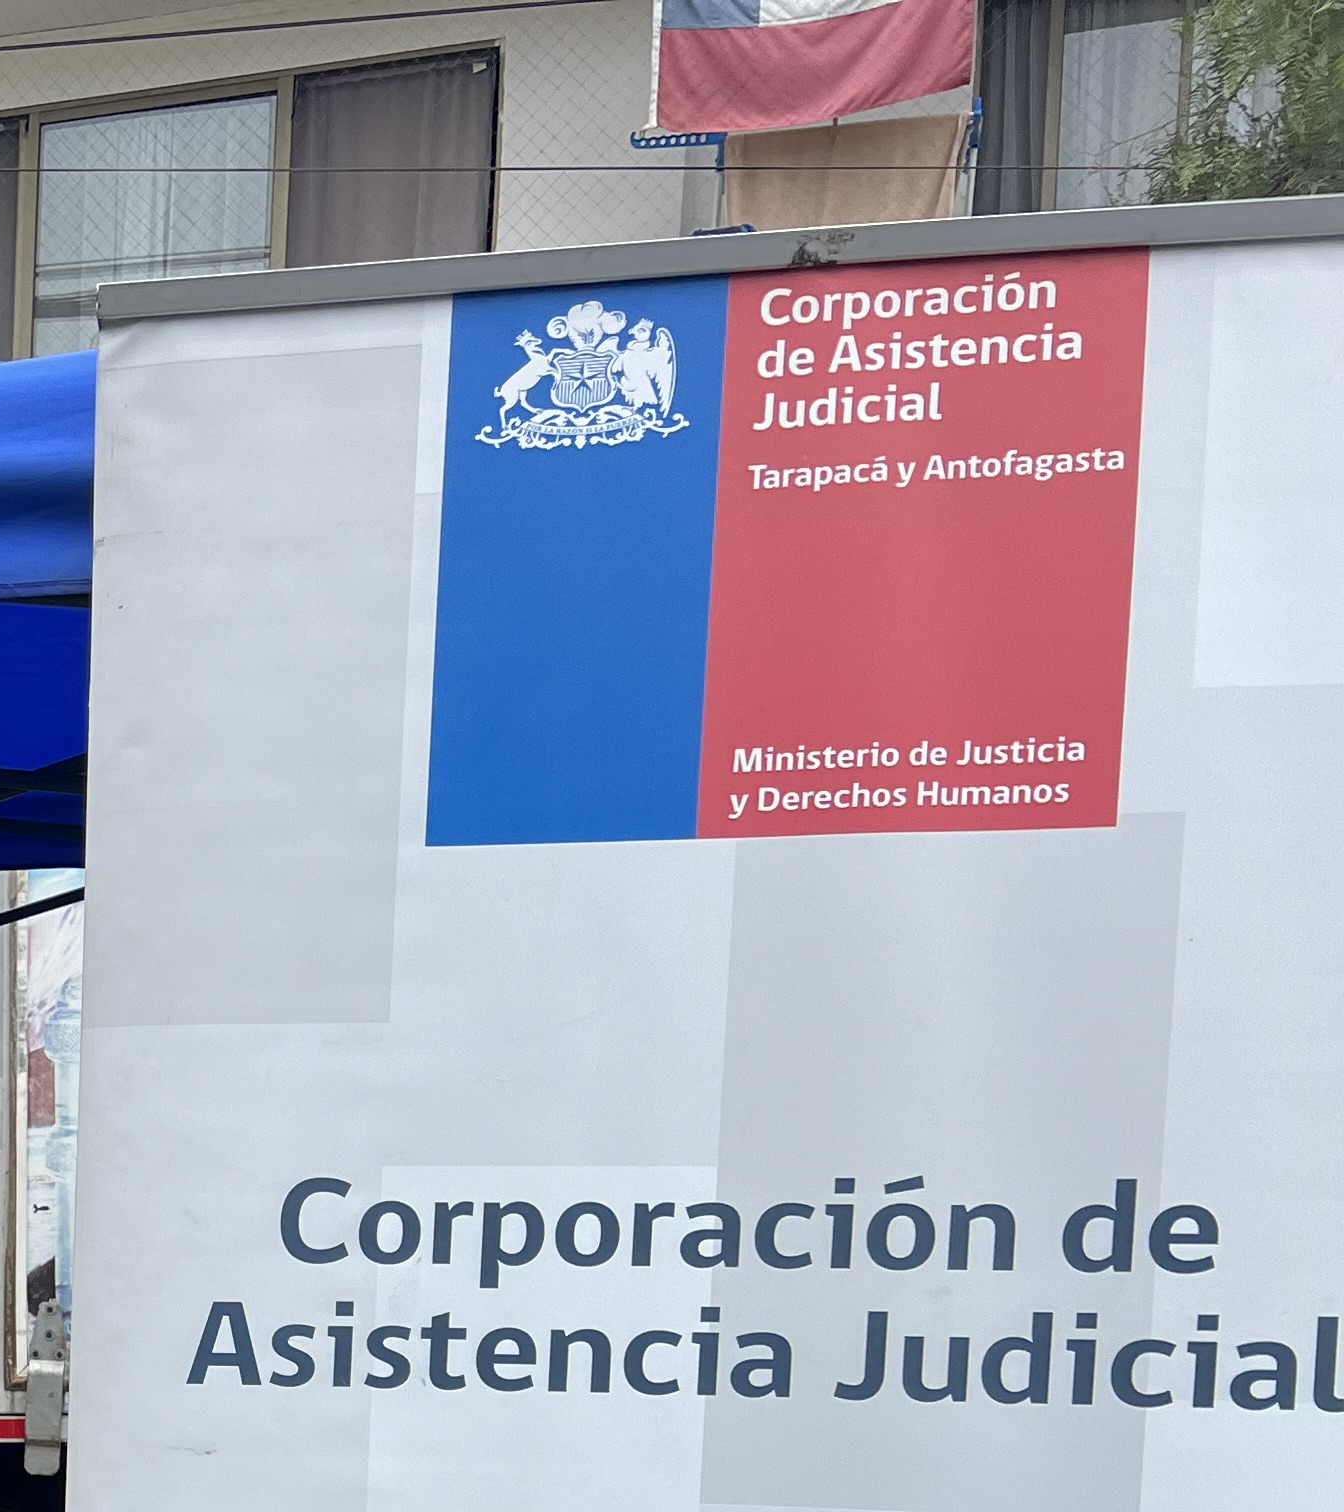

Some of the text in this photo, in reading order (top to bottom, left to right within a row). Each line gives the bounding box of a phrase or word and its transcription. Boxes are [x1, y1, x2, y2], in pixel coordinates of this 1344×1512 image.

[760, 272, 1057, 330] Corporación
[757, 323, 1083, 378] de Asistencia
[753, 382, 942, 431] Judicial
[748, 447, 1126, 491] Tarapacá y Antofagasta
[732, 736, 1086, 774] Ministerio de Justicia
[728, 780, 1070, 820] y Derechos Humanos
[278, 1175, 1222, 1290] Corporación de
[184, 1301, 1344, 1412] Asistencia Judicial
